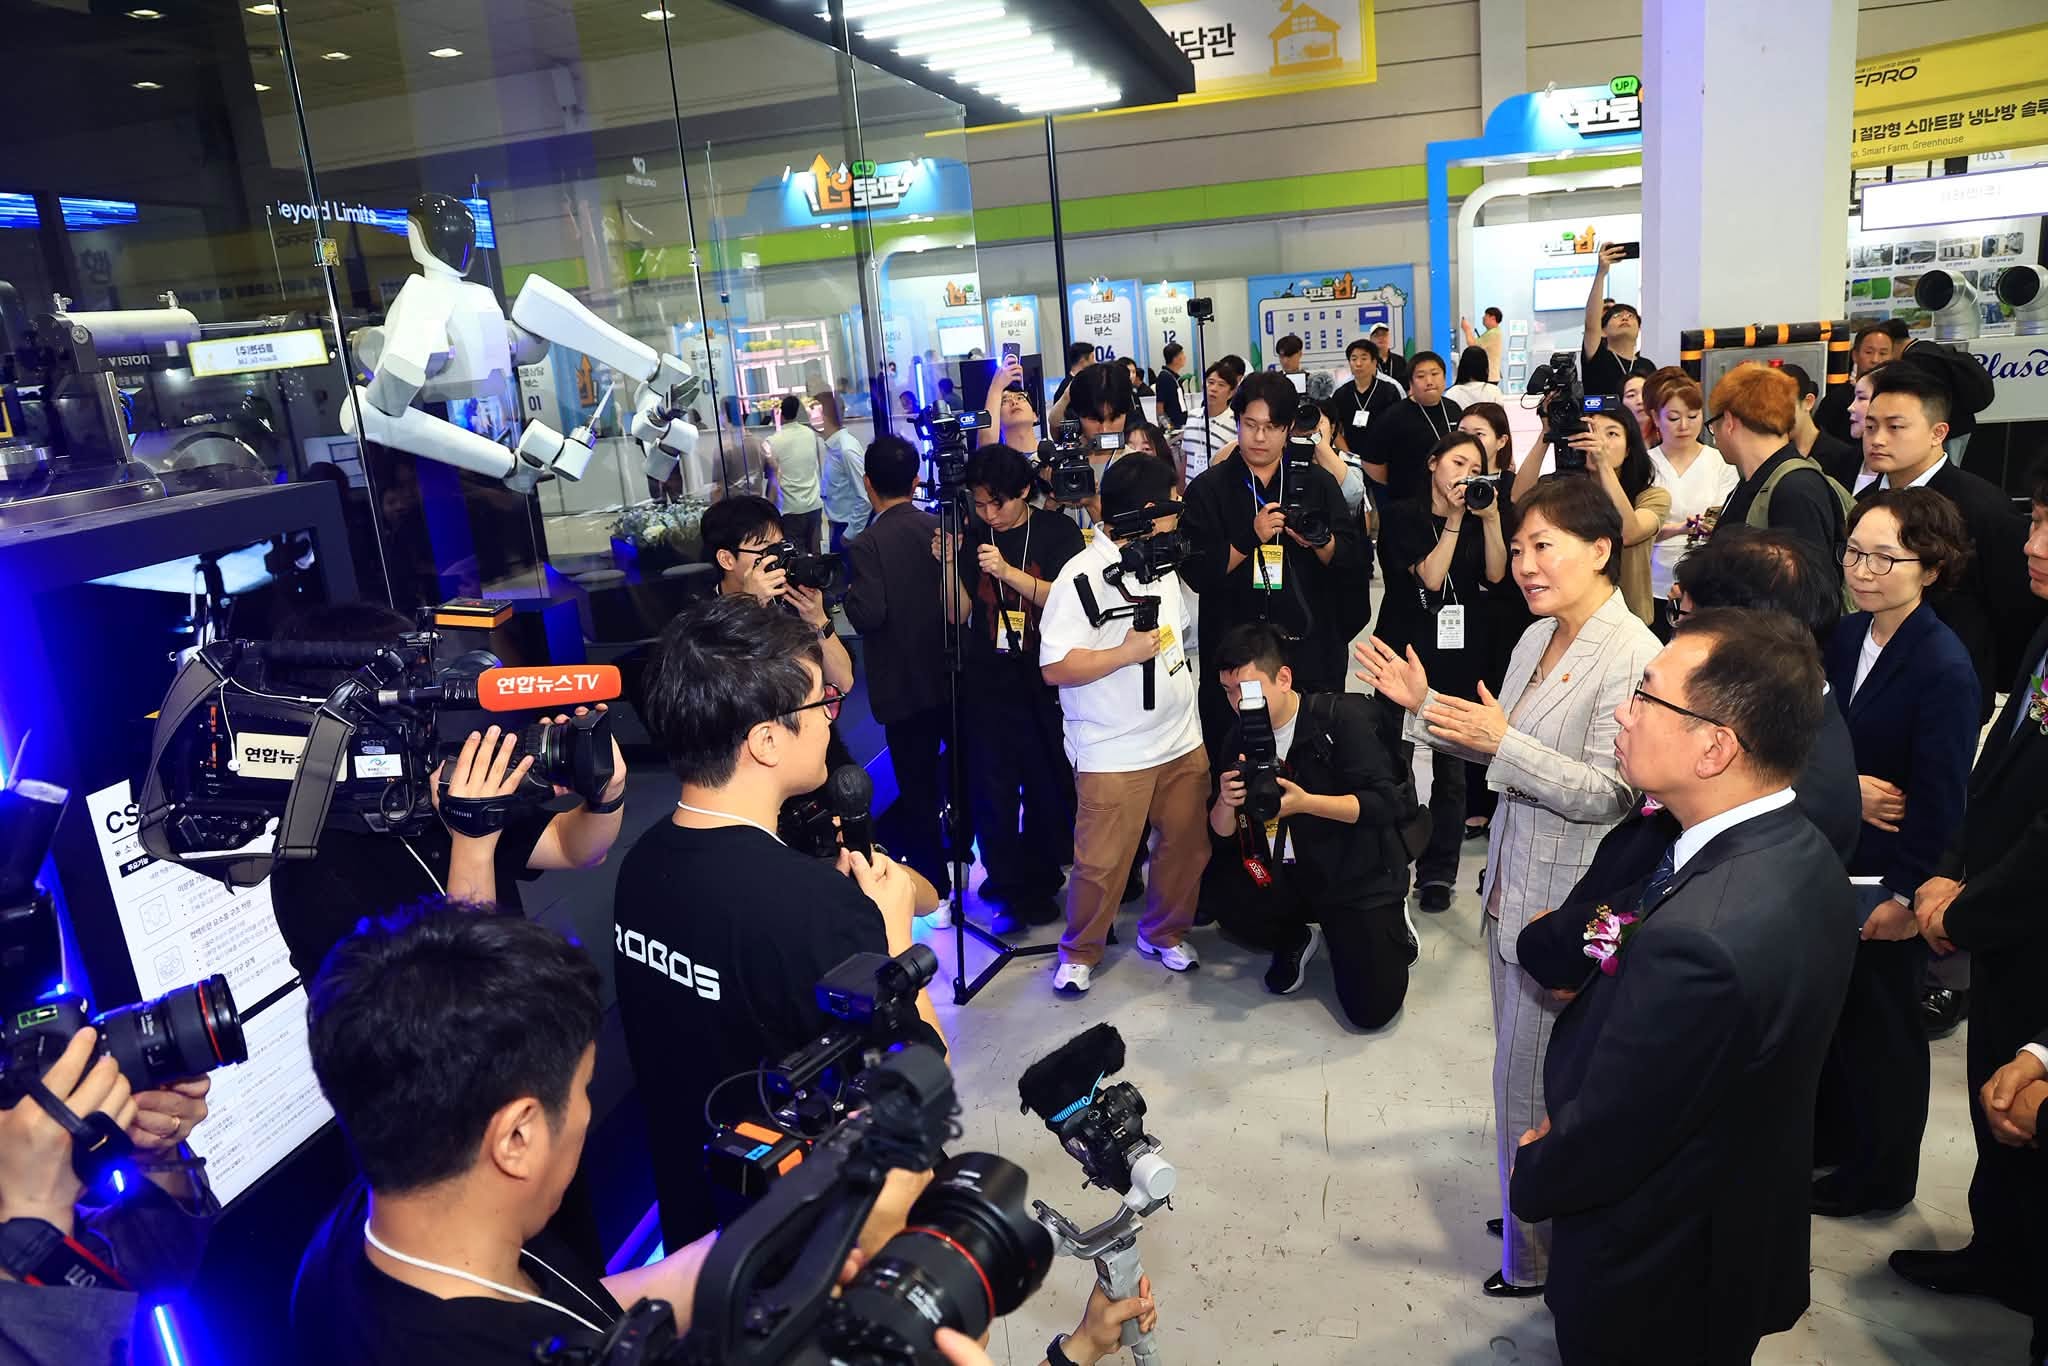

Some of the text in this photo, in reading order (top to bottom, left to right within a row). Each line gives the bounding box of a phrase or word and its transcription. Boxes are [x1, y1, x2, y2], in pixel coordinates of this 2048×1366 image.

[1171, 23, 1236, 60] 담관
[1579, 95, 1643, 133] 판로
[1860, 122, 1901, 142] 절감형
[1904, 111, 1965, 136] 스마트팜
[1969, 103, 2018, 127] 냉난방
[1862, 146, 1886, 157] Smart
[1913, 135, 1965, 150] Greenhouse
[278, 200, 377, 224] eyond Limits
[1084, 312, 1121, 325] 판로상담
[1094, 326, 1113, 336] 부스
[1162, 330, 1177, 344] 12
[1095, 344, 1116, 363] 04
[529, 395, 542, 411] 01
[496, 673, 600, 695] 연합뉴스TV
